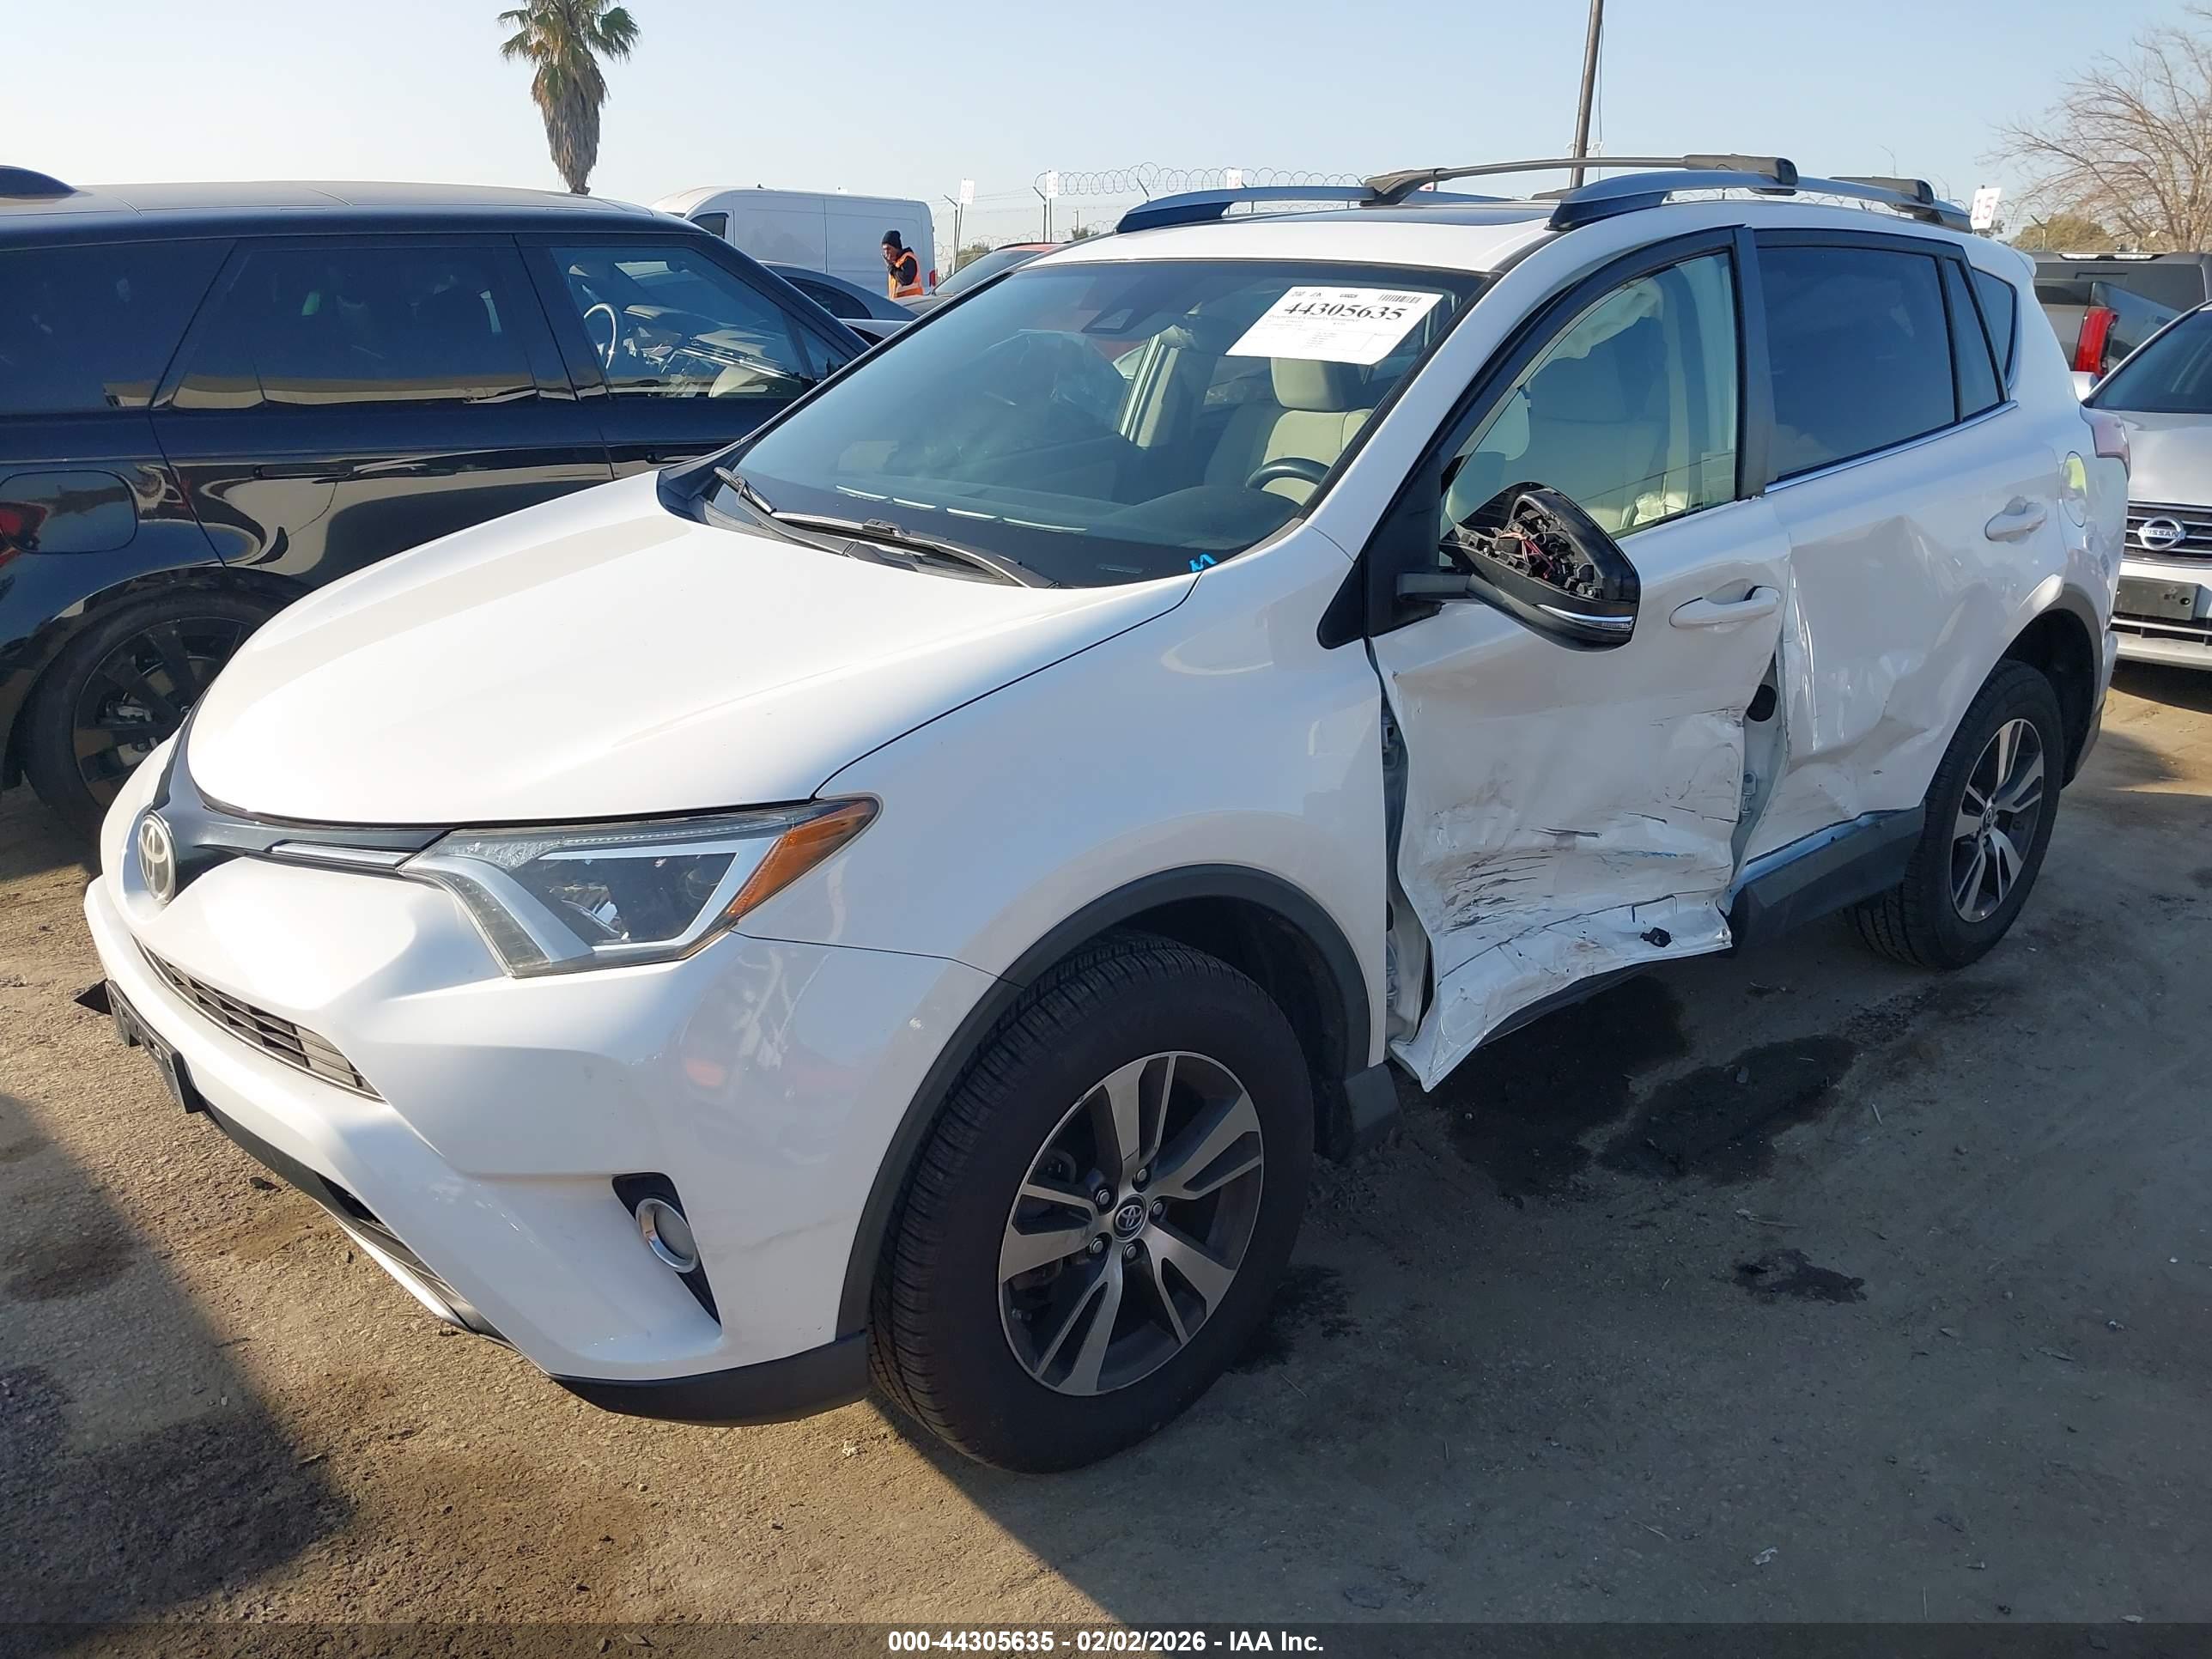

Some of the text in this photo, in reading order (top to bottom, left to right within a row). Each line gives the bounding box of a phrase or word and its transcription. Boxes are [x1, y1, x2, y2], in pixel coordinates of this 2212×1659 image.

[1972, 196, 1995, 221] 15
[1284, 301, 1408, 321] 44305635
[2142, 528, 2179, 538] NISSAN
